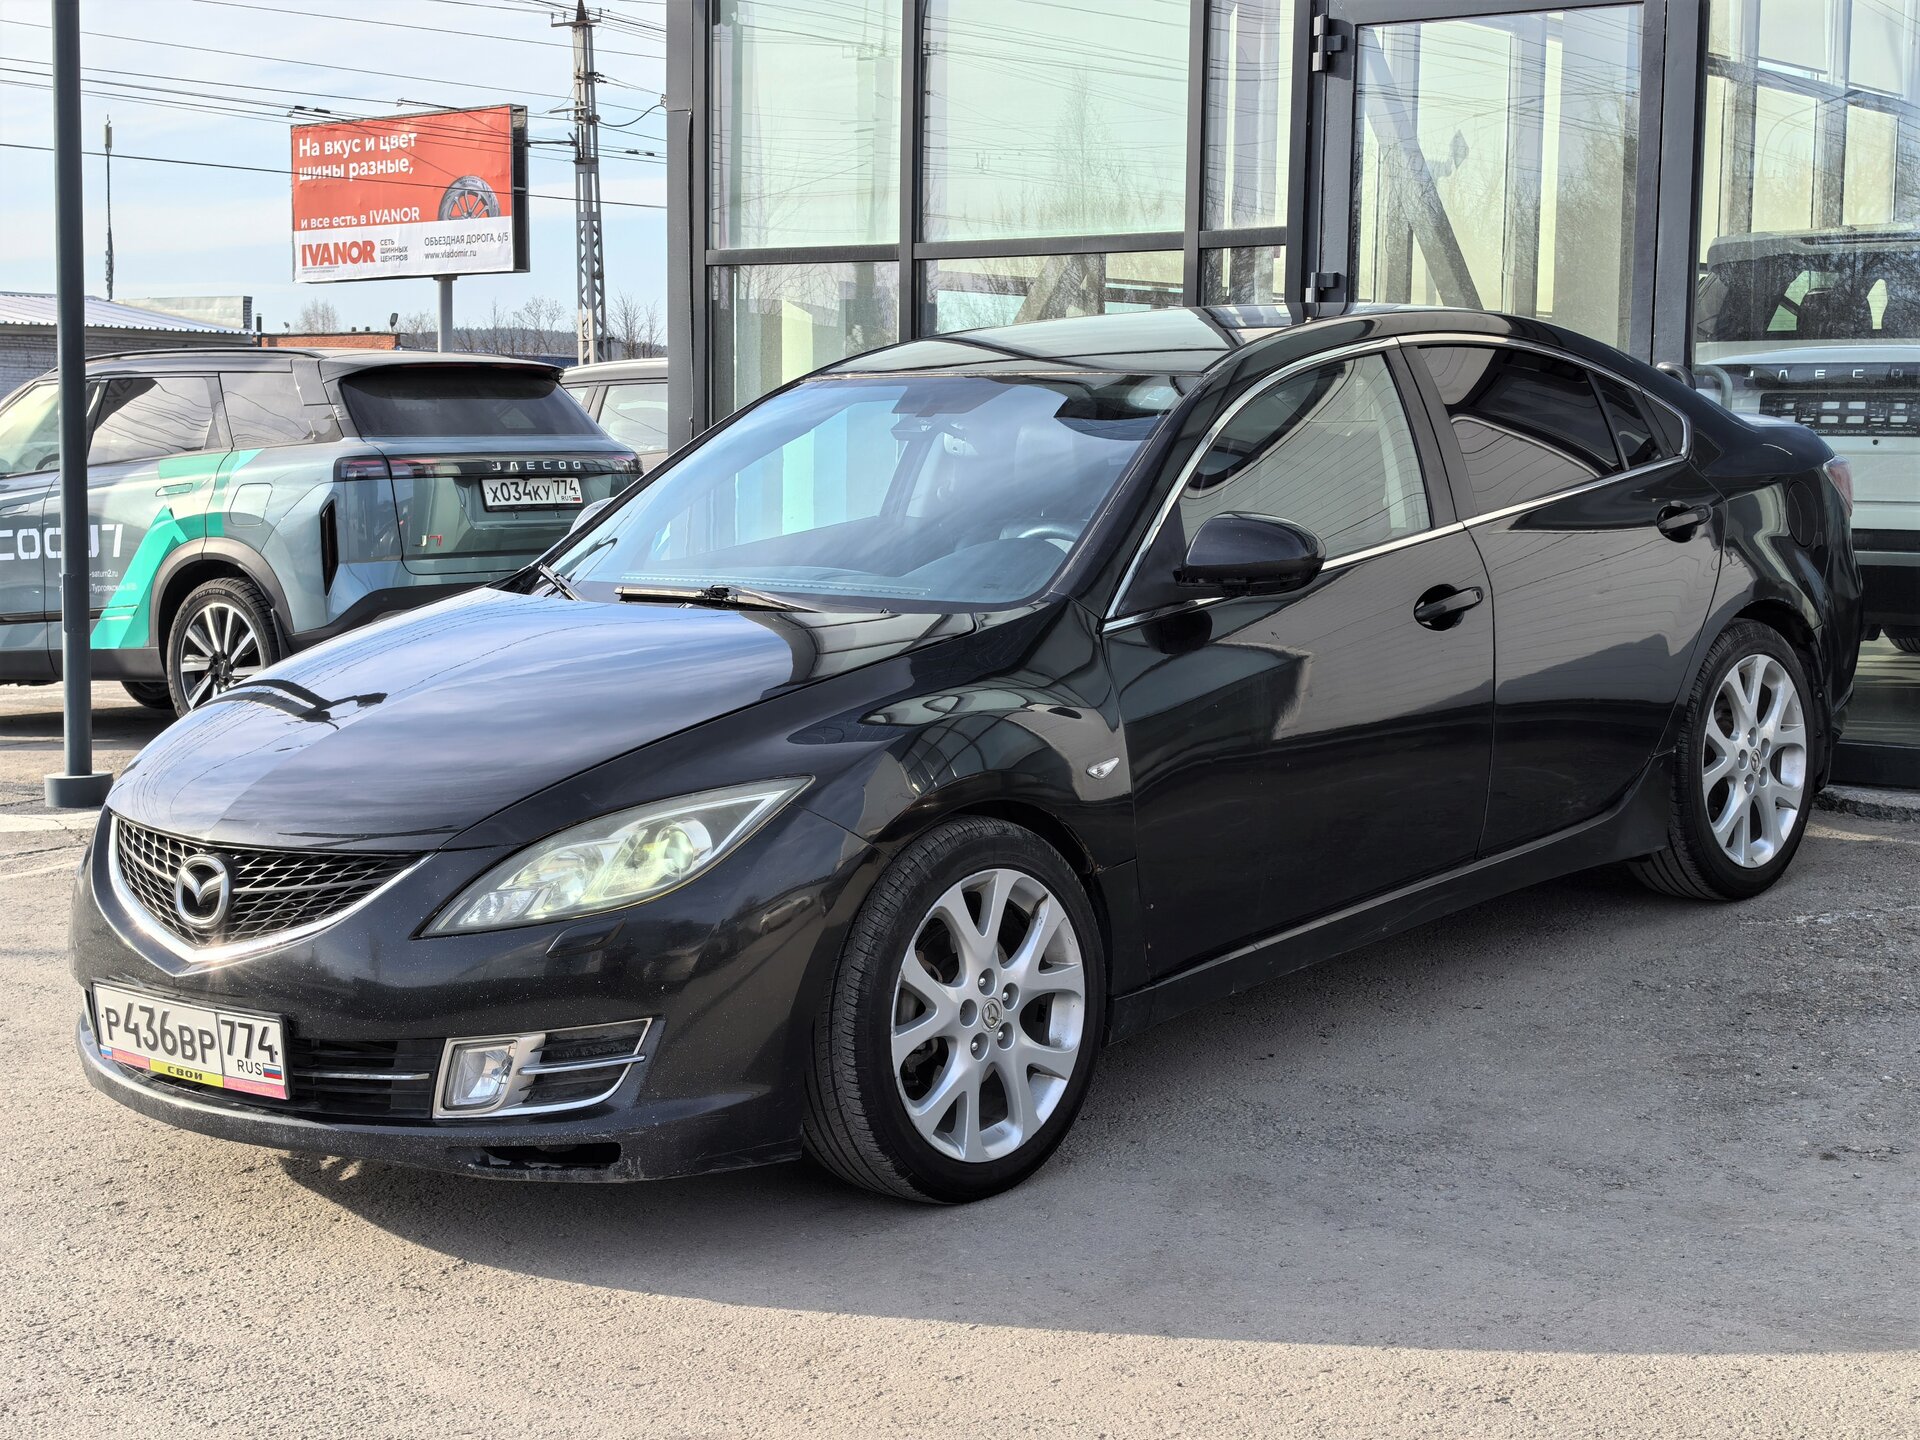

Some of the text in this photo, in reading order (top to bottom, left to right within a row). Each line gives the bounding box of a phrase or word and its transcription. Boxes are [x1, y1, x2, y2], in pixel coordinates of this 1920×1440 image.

[299, 132, 417, 159] На вкус и цвет
[299, 157, 414, 182] шины разные,
[301, 207, 421, 229] и все есть в IVANOR
[380, 239, 395, 247] СЕТЬ
[424, 234, 465, 247] ОБЪЕЗДНАЯ
[497, 231, 509, 244] 6/5
[301, 239, 376, 267] IVANOR
[380, 246, 408, 255] ШИННЫХ
[380, 254, 408, 263] ЦЕНТРОВ
[492, 461, 581, 471] JAECOO
[489, 480, 577, 503] Х034КУ 774
[105, 1002, 275, 1064] Р436ВР 774
[237, 1059, 263, 1076] RUS
